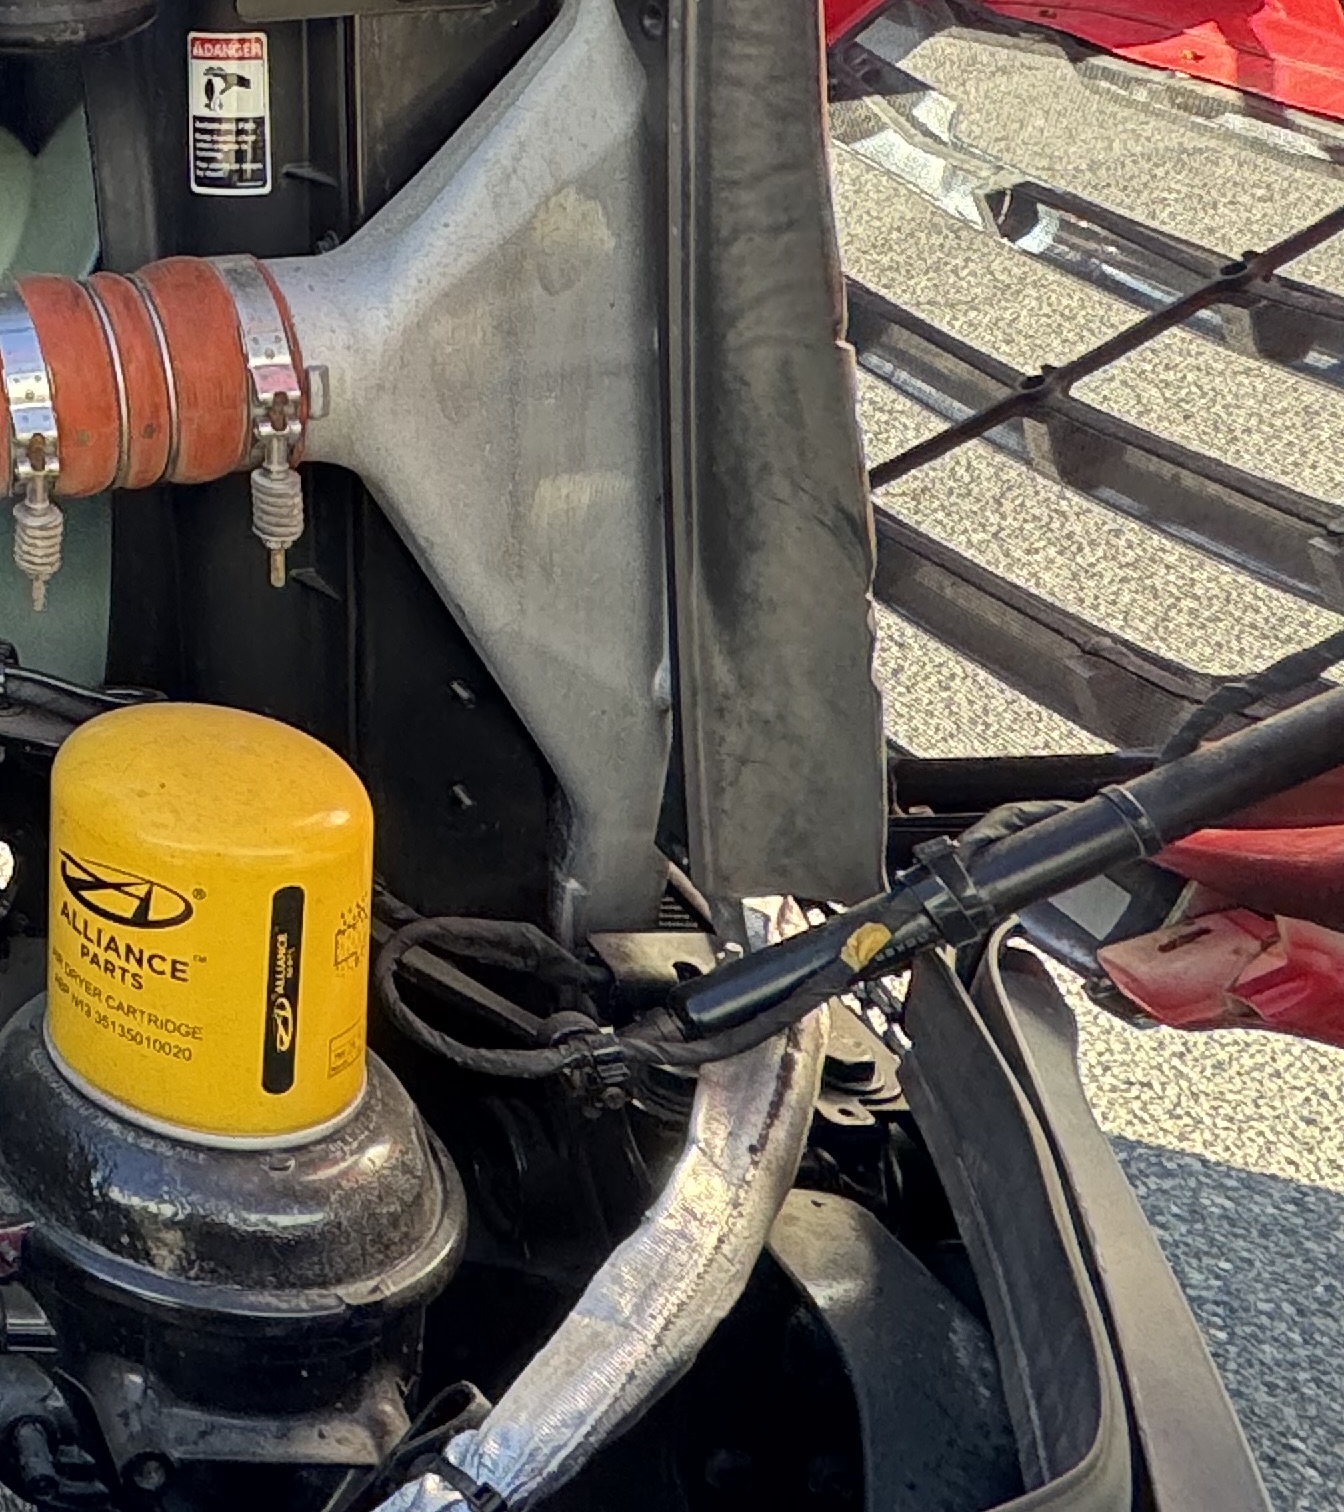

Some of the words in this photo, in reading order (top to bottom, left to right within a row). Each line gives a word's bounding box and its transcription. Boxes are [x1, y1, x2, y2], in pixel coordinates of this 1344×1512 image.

[203, 42, 262, 58] DANGER
[60, 900, 190, 983] ALLIANCE
[80, 942, 144, 991] PARTS
[64, 960, 103, 1004] DRYER
[105, 994, 204, 1041] CARTRIDGE
